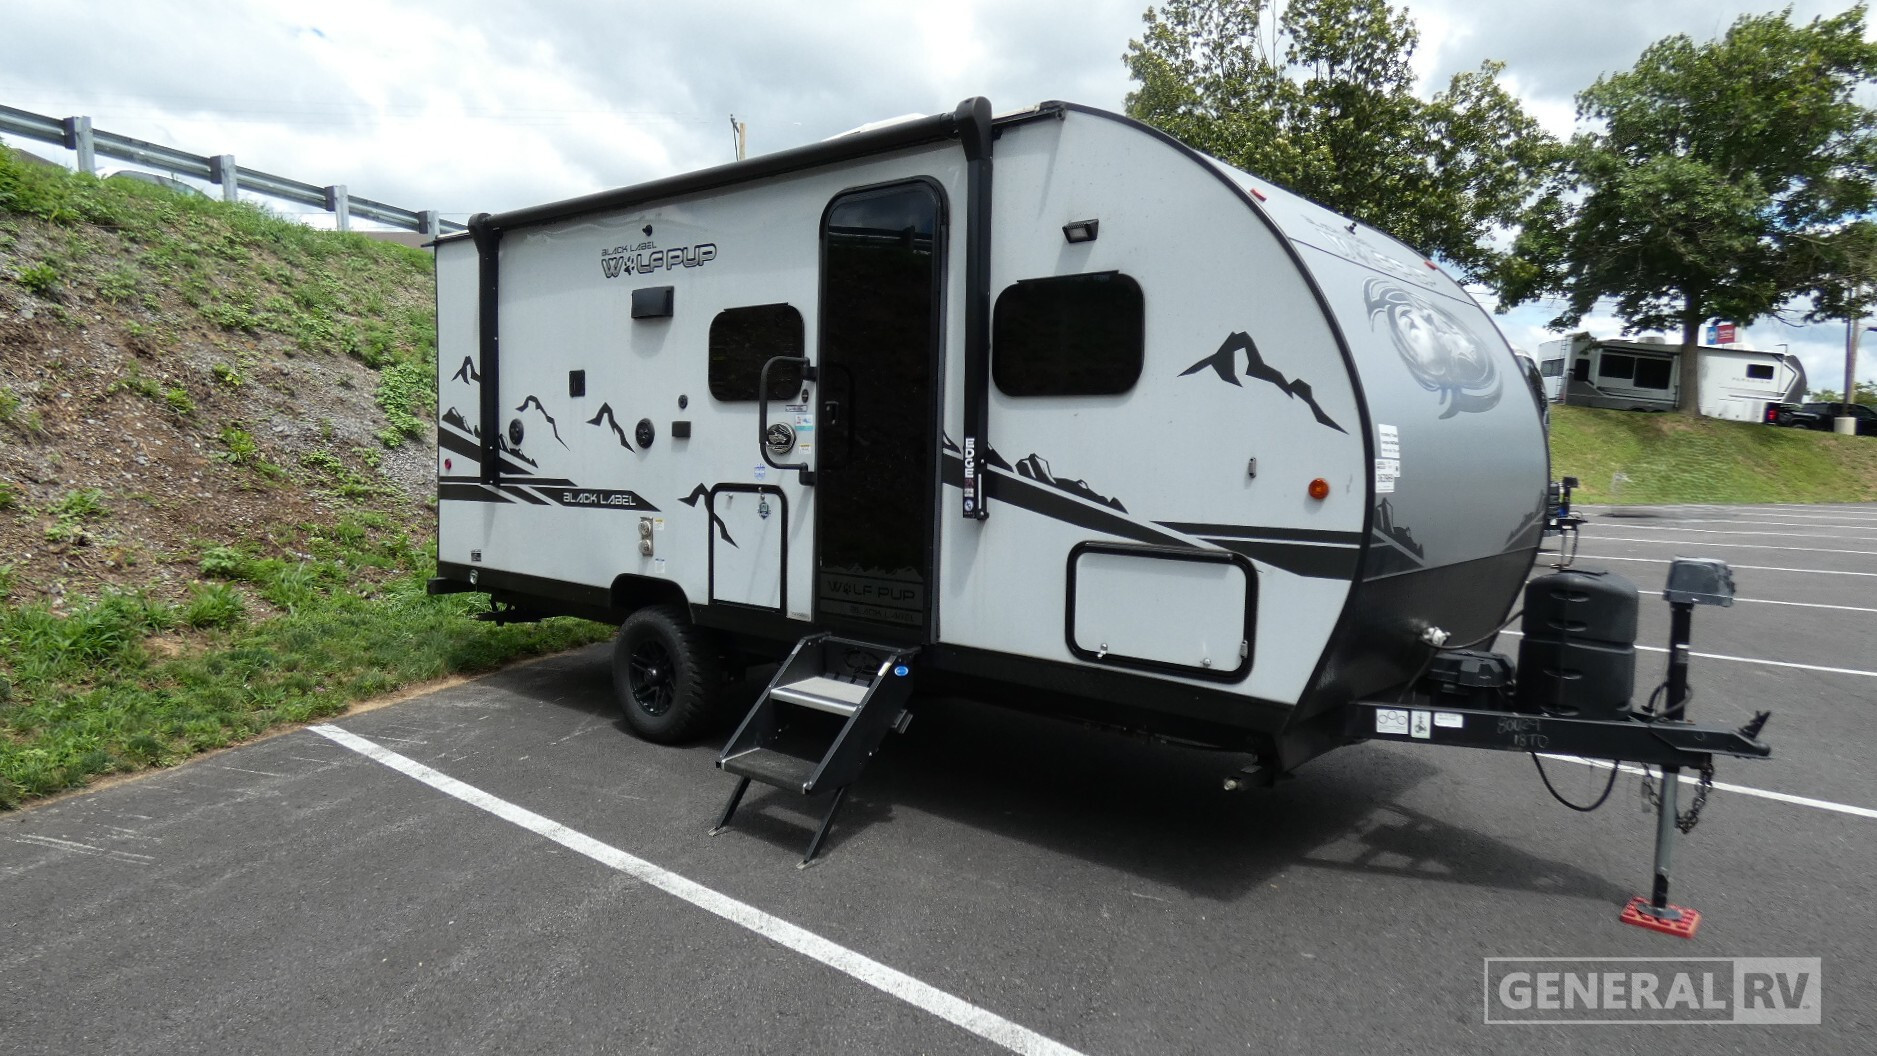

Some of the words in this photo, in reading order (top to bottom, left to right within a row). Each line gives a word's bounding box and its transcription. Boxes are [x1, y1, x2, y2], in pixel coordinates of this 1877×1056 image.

[602, 245, 628, 256] BLACK
[630, 241, 657, 252] LABEL
[666, 243, 717, 271] PUP
[964, 437, 975, 478] EDGE
[563, 492, 598, 504] BLACK
[600, 494, 637, 506] LABEL
[878, 587, 915, 601] PUP
